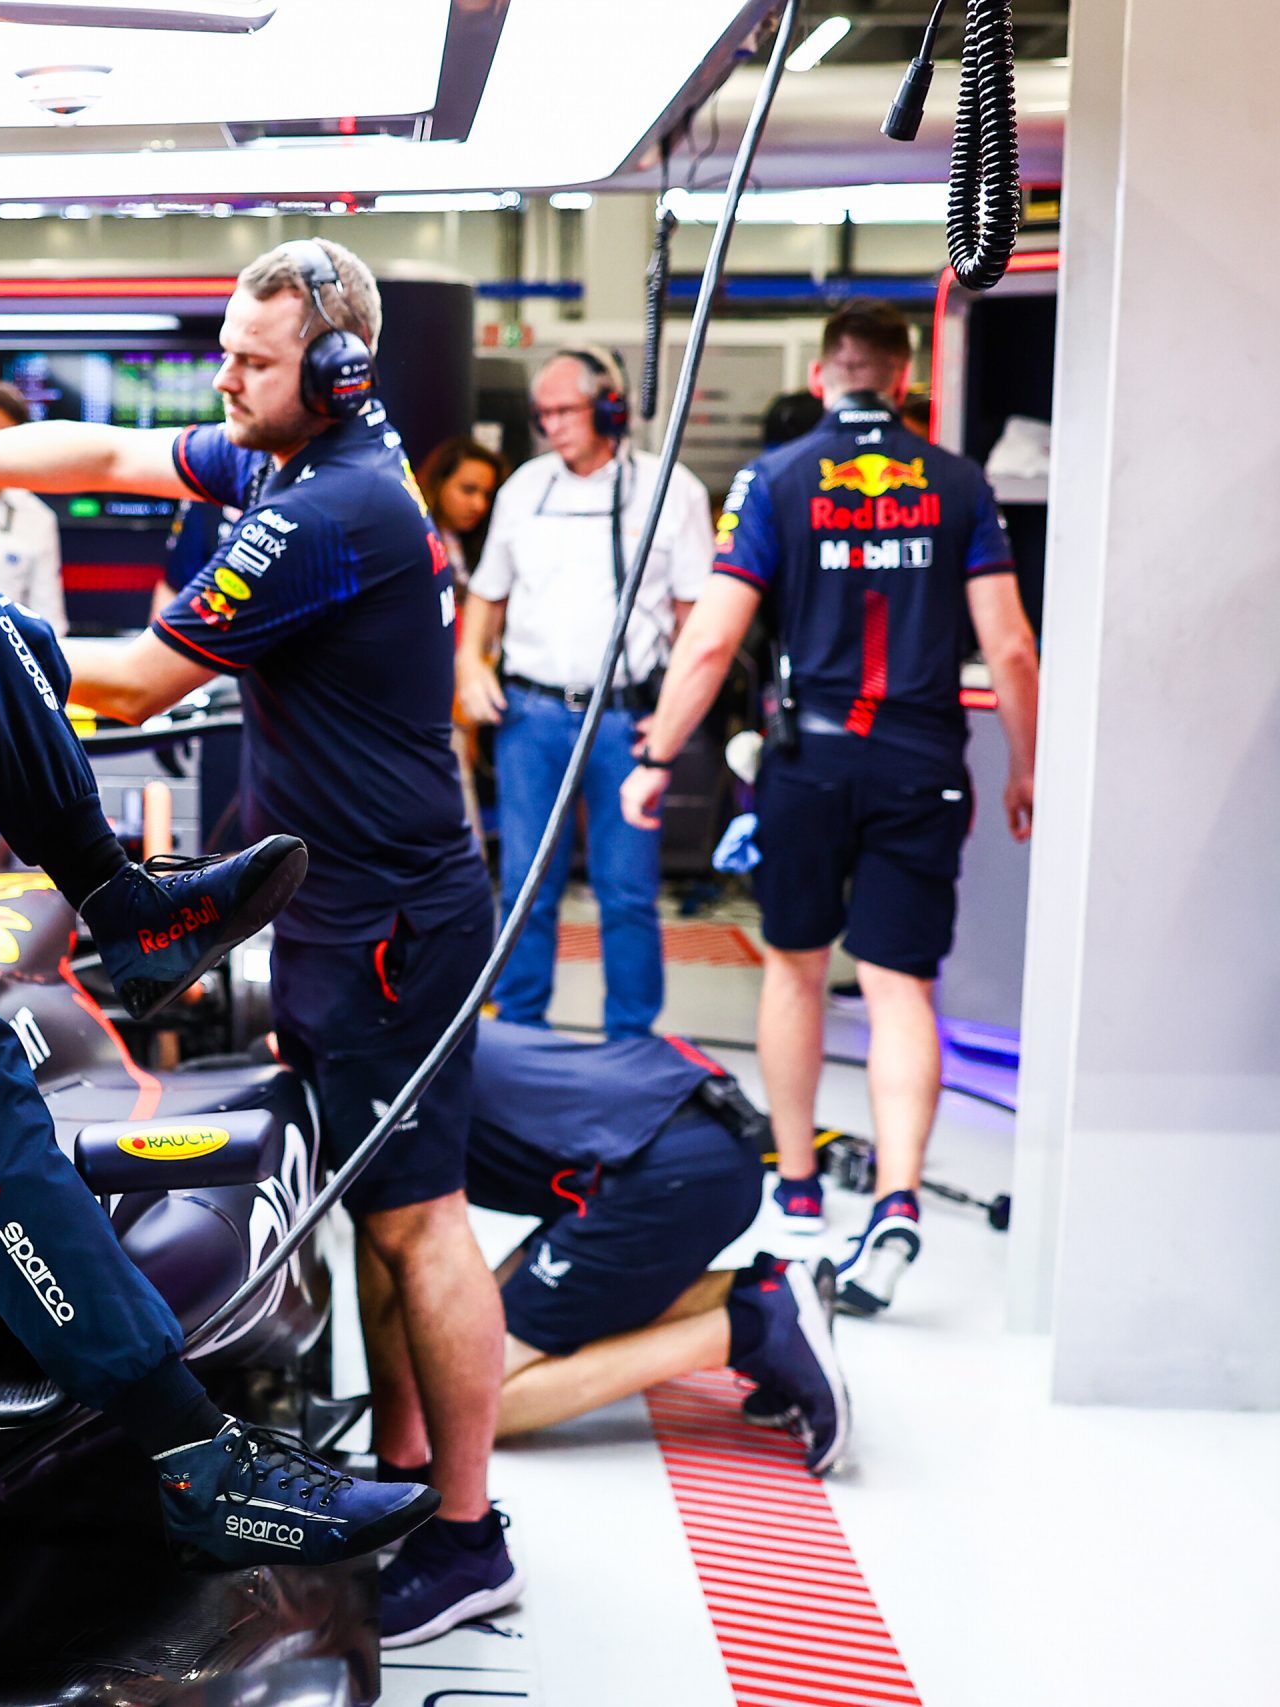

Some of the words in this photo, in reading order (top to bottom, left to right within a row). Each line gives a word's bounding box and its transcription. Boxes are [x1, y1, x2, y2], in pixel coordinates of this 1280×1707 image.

[810, 491, 873, 530] Red
[875, 494, 941, 530] Bull
[820, 539, 901, 571] Mobil
[0, 615, 60, 711] sparco
[146, 1132, 216, 1149] RAUCH
[225, 1514, 304, 1550] sparco
